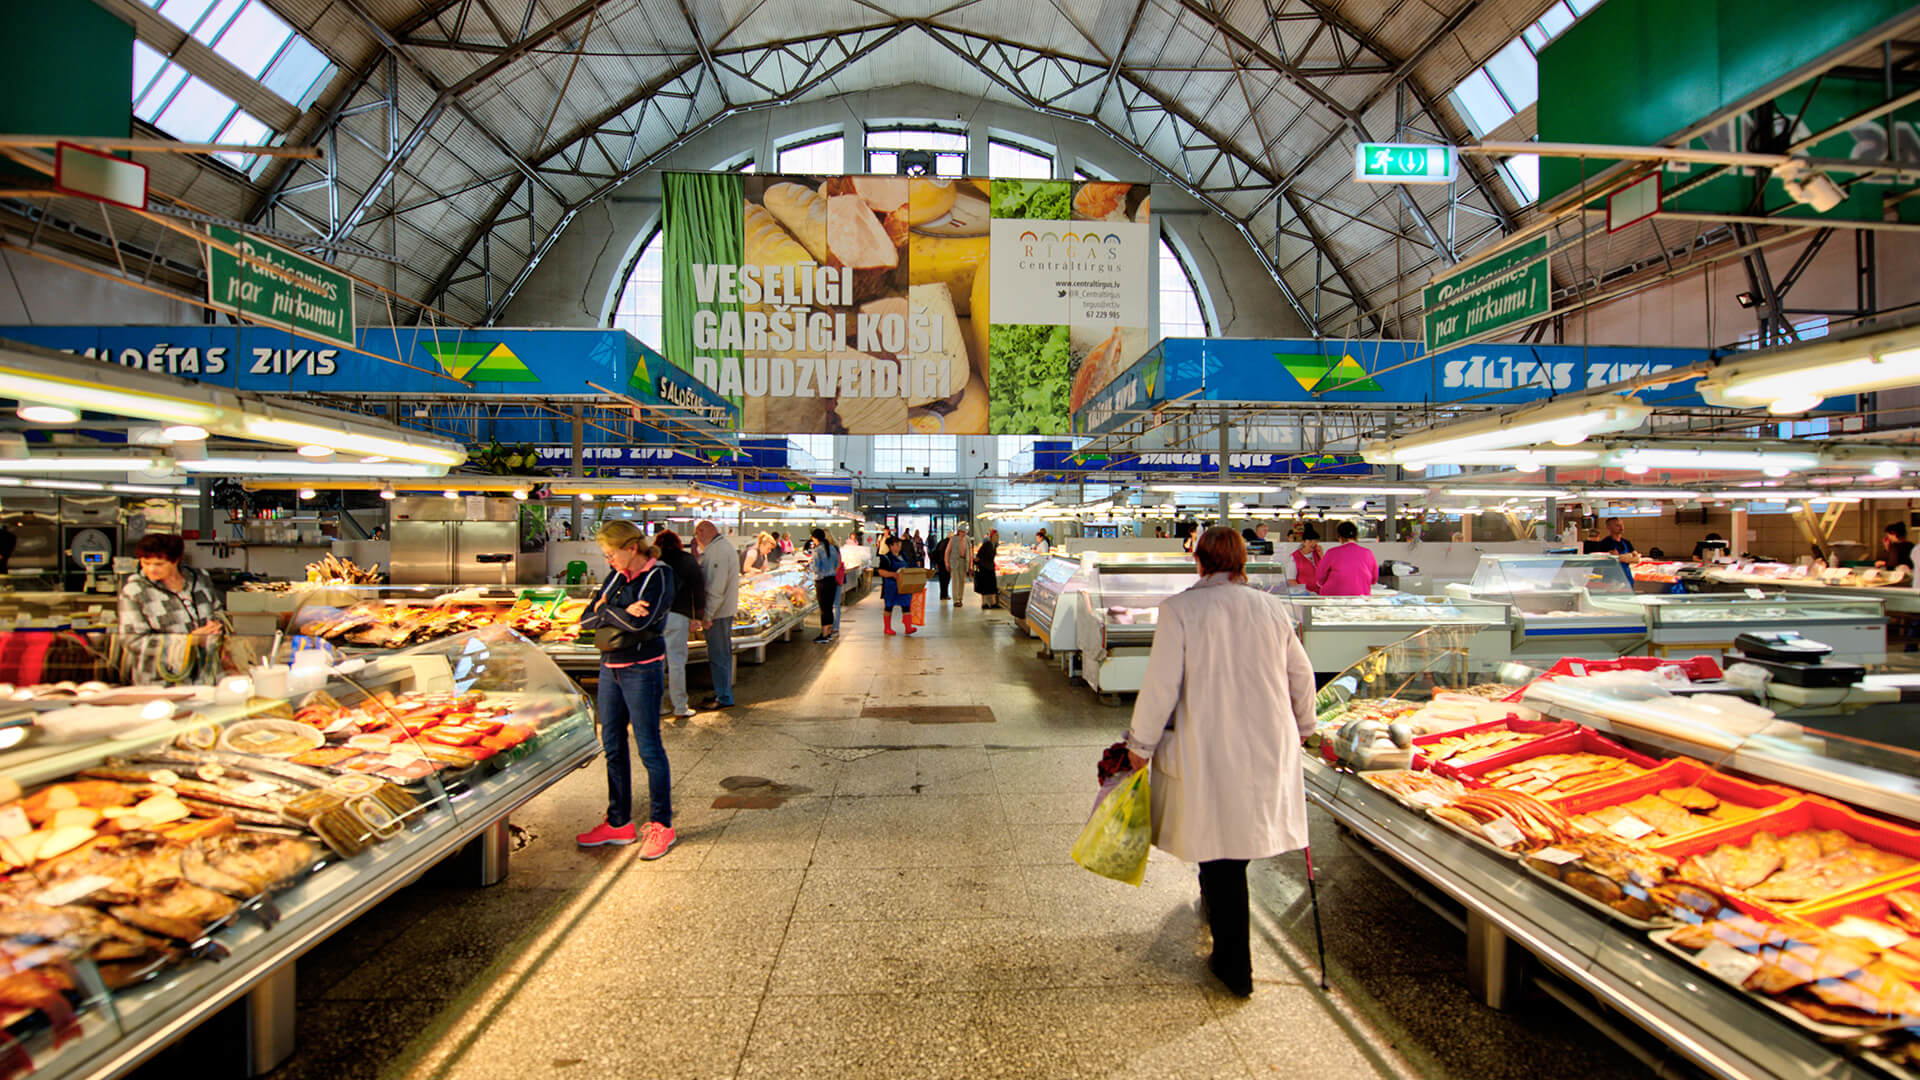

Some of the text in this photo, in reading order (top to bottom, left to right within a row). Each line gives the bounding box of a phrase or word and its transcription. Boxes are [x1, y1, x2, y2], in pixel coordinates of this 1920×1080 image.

[227, 276, 263, 303] par
[692, 261, 854, 306] VESELĪGI
[694, 305, 847, 353] GARŠĪGI
[1435, 314, 1460, 344] par
[250, 349, 338, 376] ZIVIS
[693, 355, 951, 399] DAUDZVEIDĪGI
